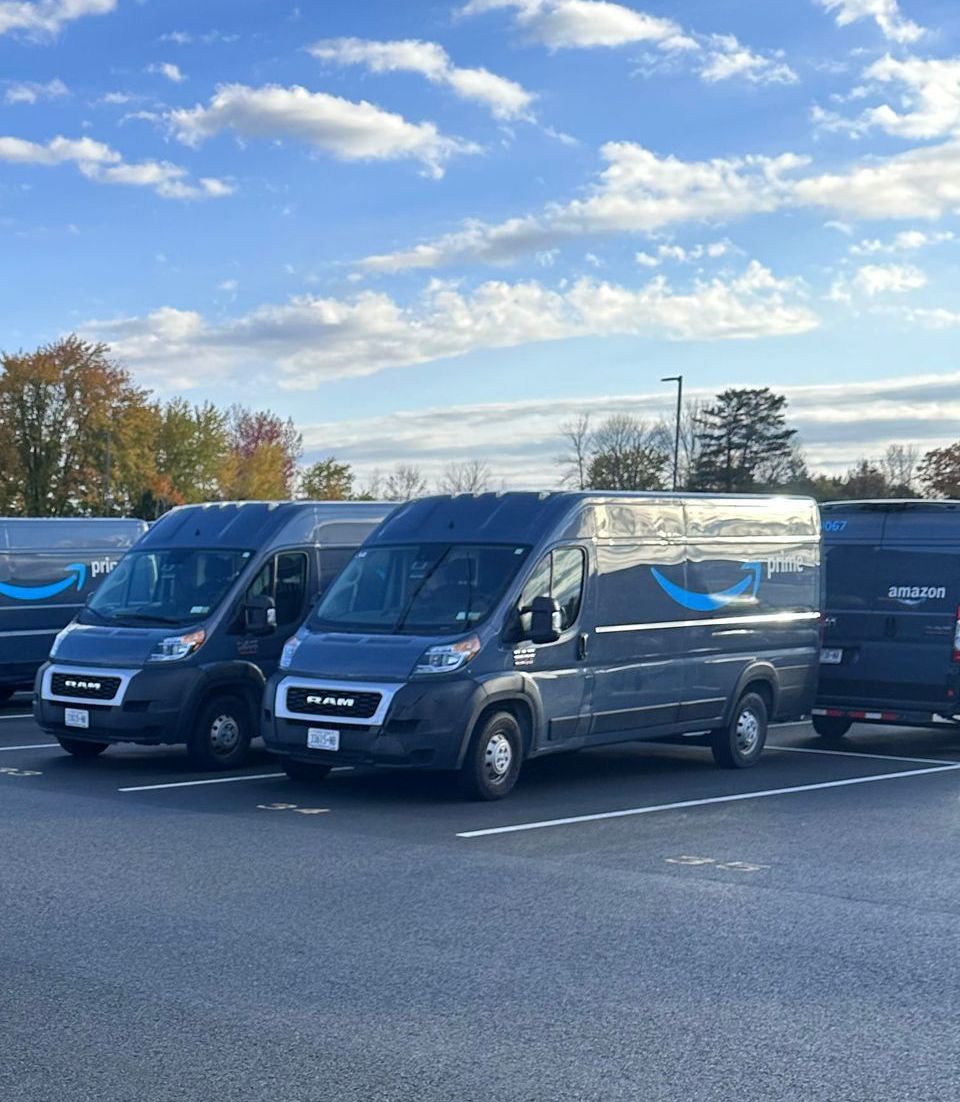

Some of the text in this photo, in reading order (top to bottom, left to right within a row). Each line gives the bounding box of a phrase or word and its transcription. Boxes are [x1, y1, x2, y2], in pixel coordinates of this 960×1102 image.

[823, 520, 848, 531] 067
[767, 551, 804, 579] prime
[888, 585, 946, 599] amazon
[306, 695, 355, 707] RAM
